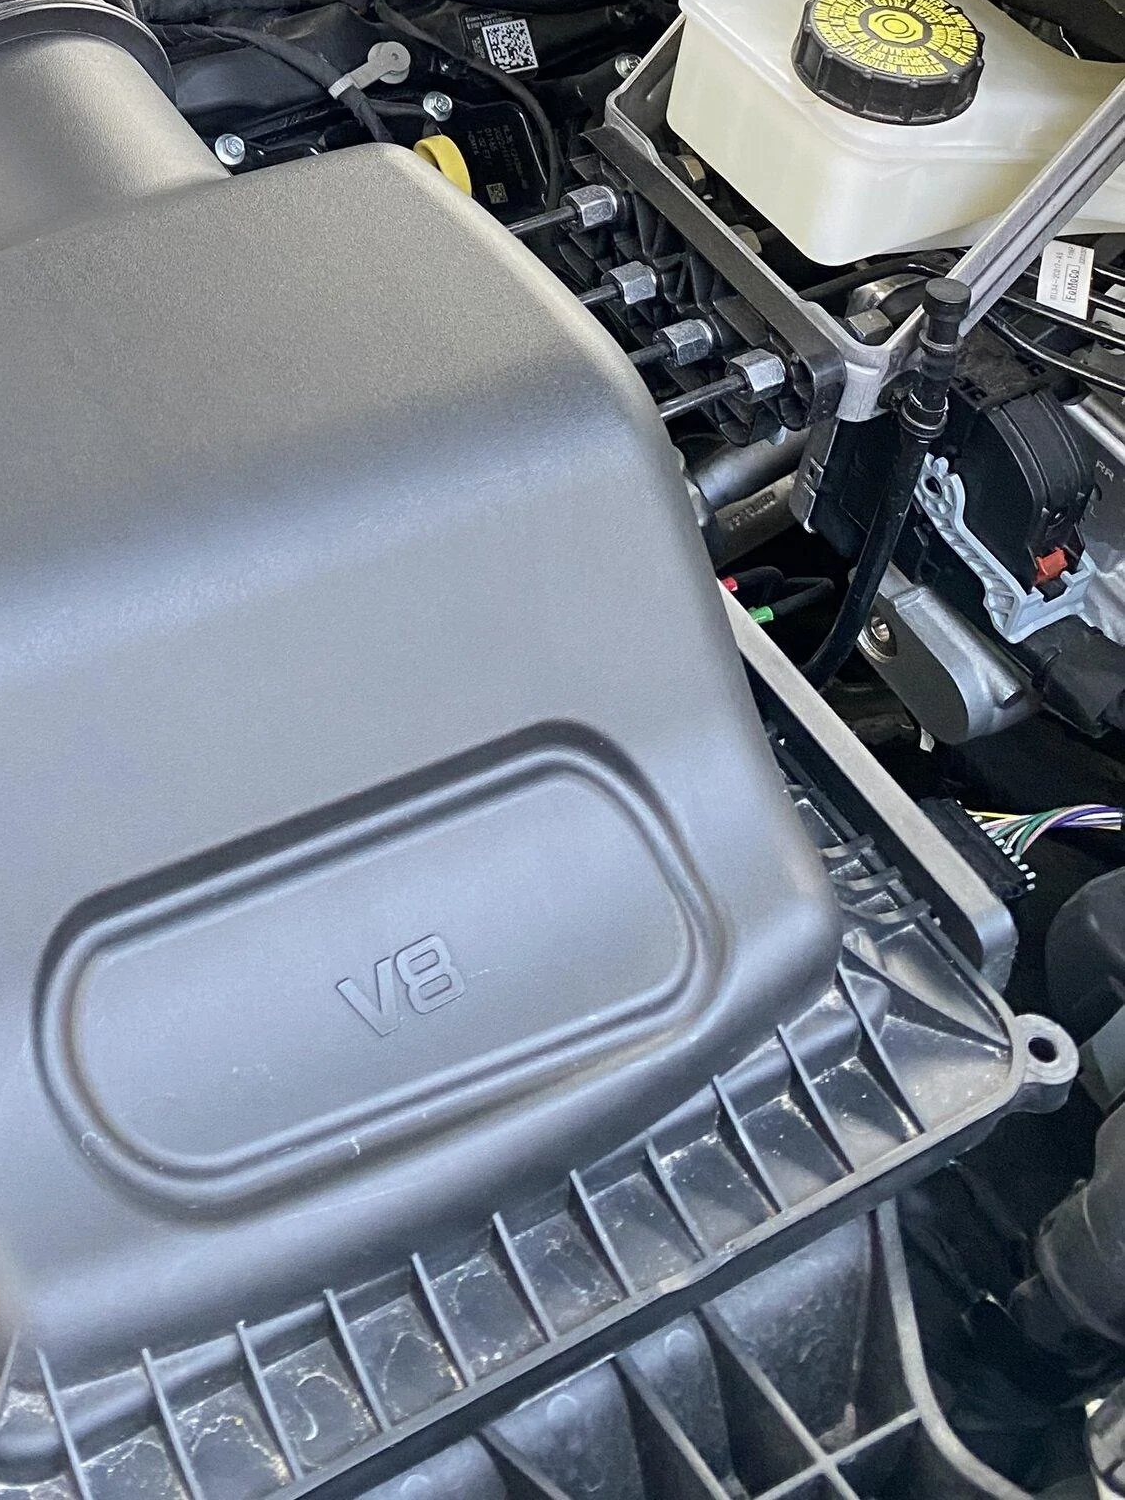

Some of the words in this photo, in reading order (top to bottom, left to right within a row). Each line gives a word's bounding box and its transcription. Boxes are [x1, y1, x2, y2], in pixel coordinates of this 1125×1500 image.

[909, 4, 937, 23] CLEAN
[1066, 269, 1080, 302] FoMoCo
[335, 934, 465, 1038] V8
